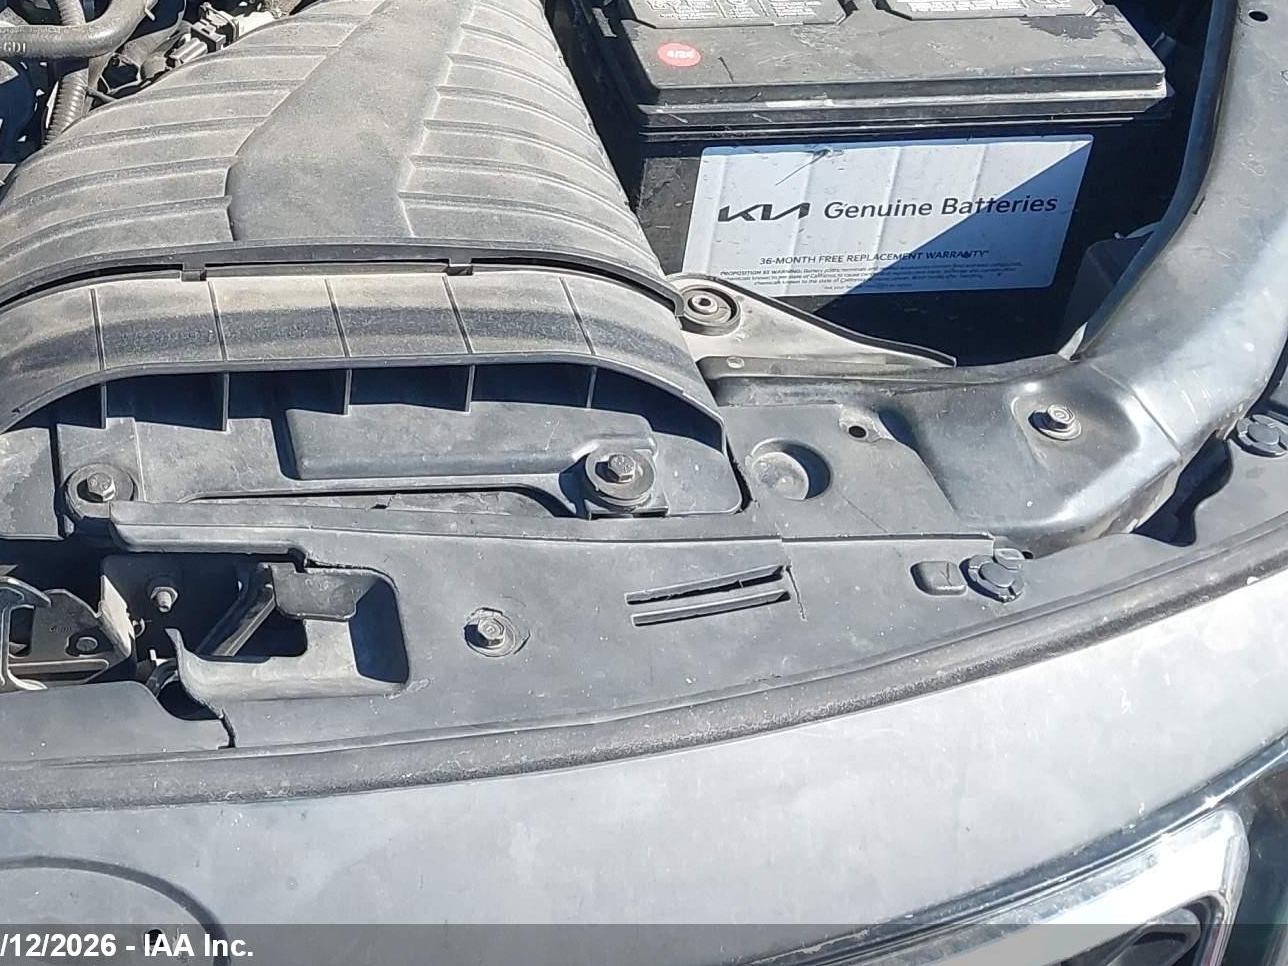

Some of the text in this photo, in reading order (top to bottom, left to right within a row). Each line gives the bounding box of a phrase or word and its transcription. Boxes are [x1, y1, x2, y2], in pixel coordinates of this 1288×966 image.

[716, 195, 1059, 223] KIA Genuine Batteries
[759, 256, 816, 265] 36-MONTH
[818, 255, 845, 264] FREE
[846, 251, 923, 263] REPLACEMENT
